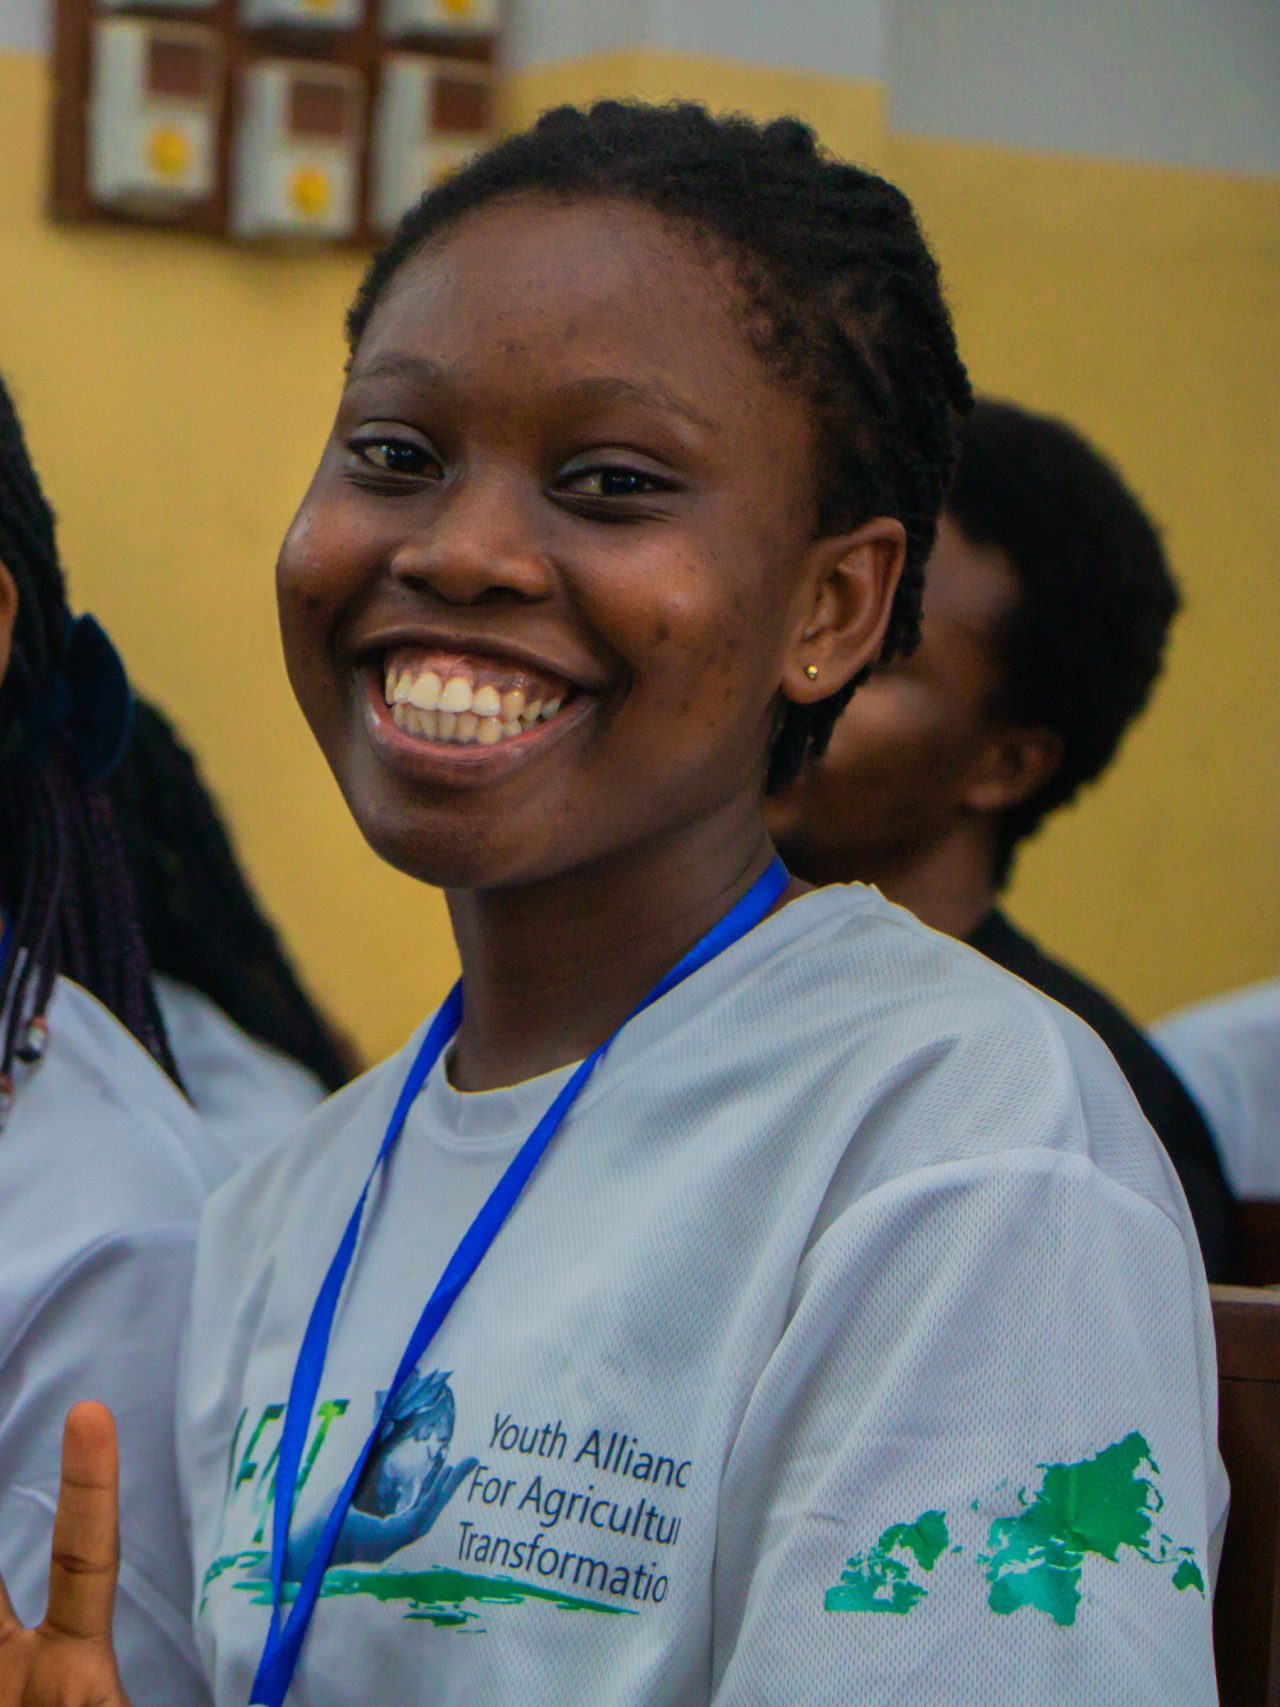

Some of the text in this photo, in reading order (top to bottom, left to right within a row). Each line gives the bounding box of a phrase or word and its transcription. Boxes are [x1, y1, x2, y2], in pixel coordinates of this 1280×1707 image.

[489, 1412, 568, 1459] Youth
[467, 1465, 682, 1546] For Agricultu
[458, 1521, 669, 1603] Transformatio
